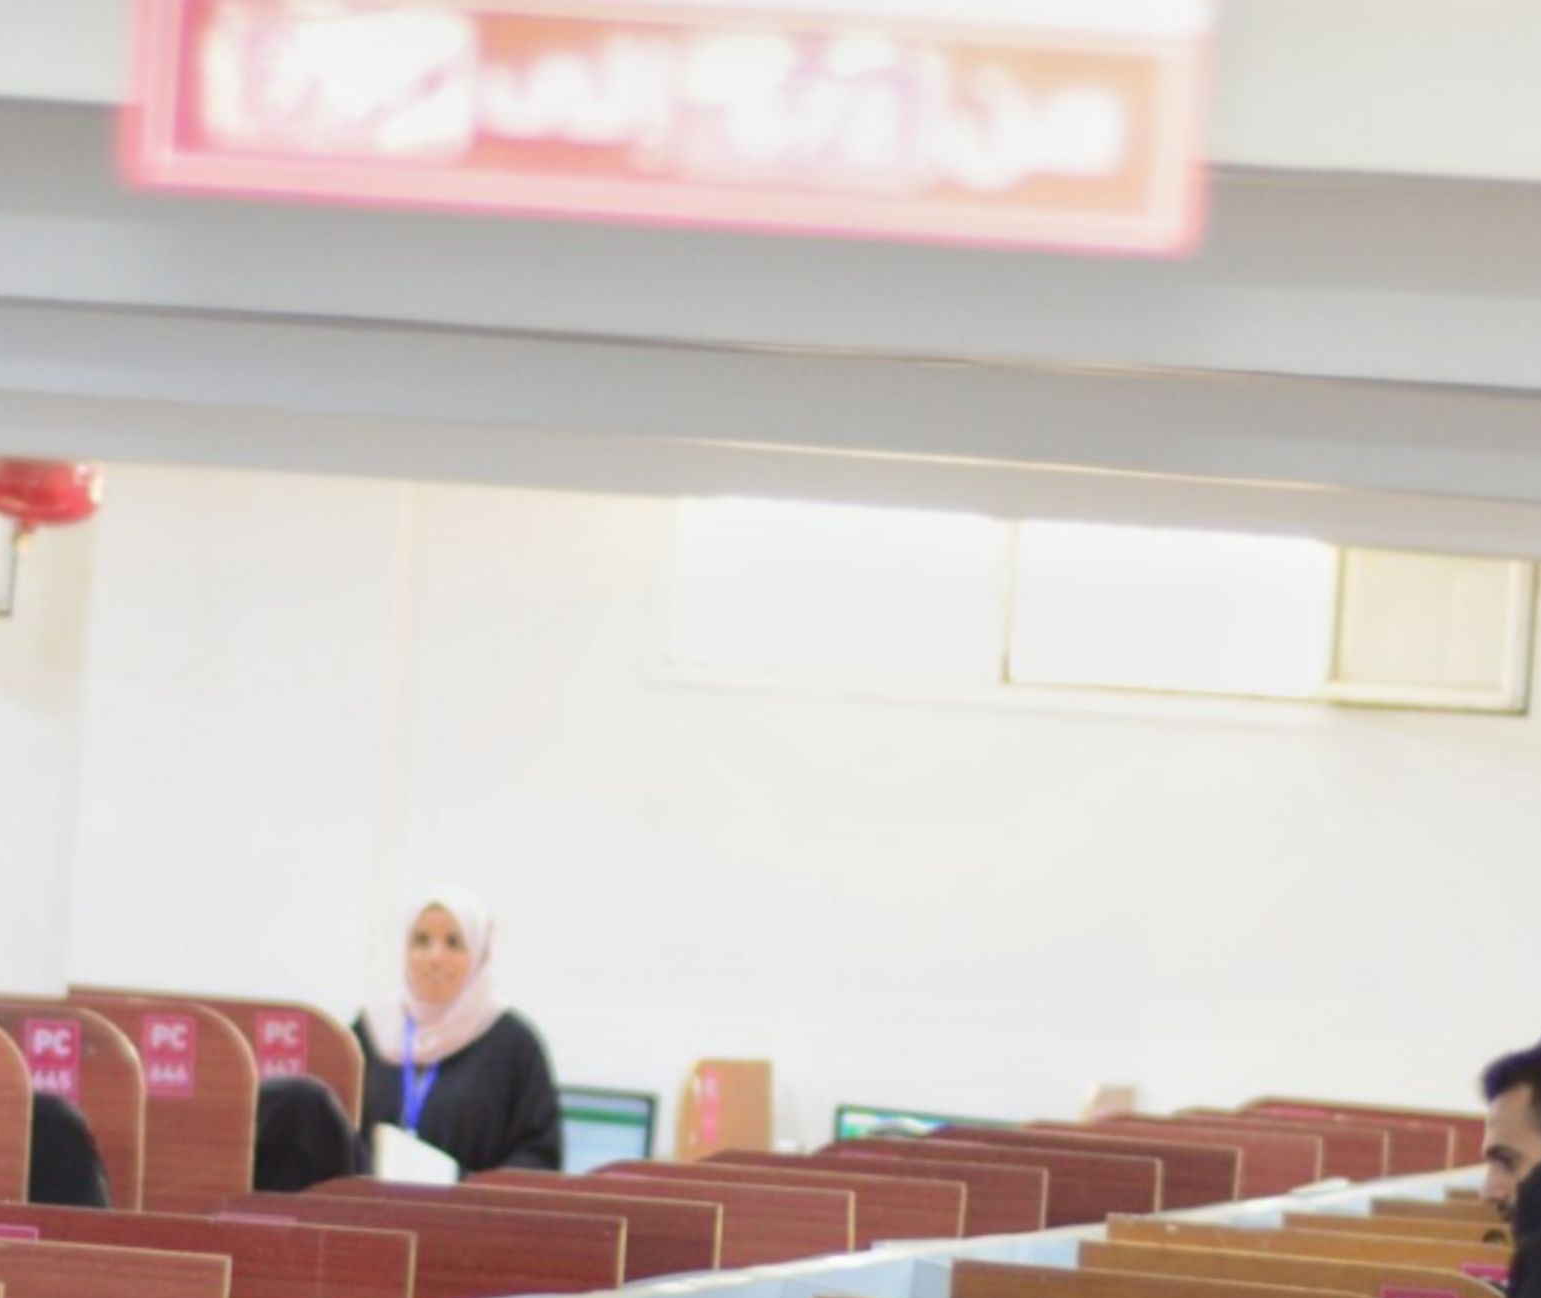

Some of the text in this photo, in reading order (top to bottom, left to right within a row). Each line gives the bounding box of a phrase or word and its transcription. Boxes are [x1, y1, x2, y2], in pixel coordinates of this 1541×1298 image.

[32, 1028, 71, 1058] PC
[150, 1023, 188, 1051] PC
[264, 1020, 300, 1047] PC
